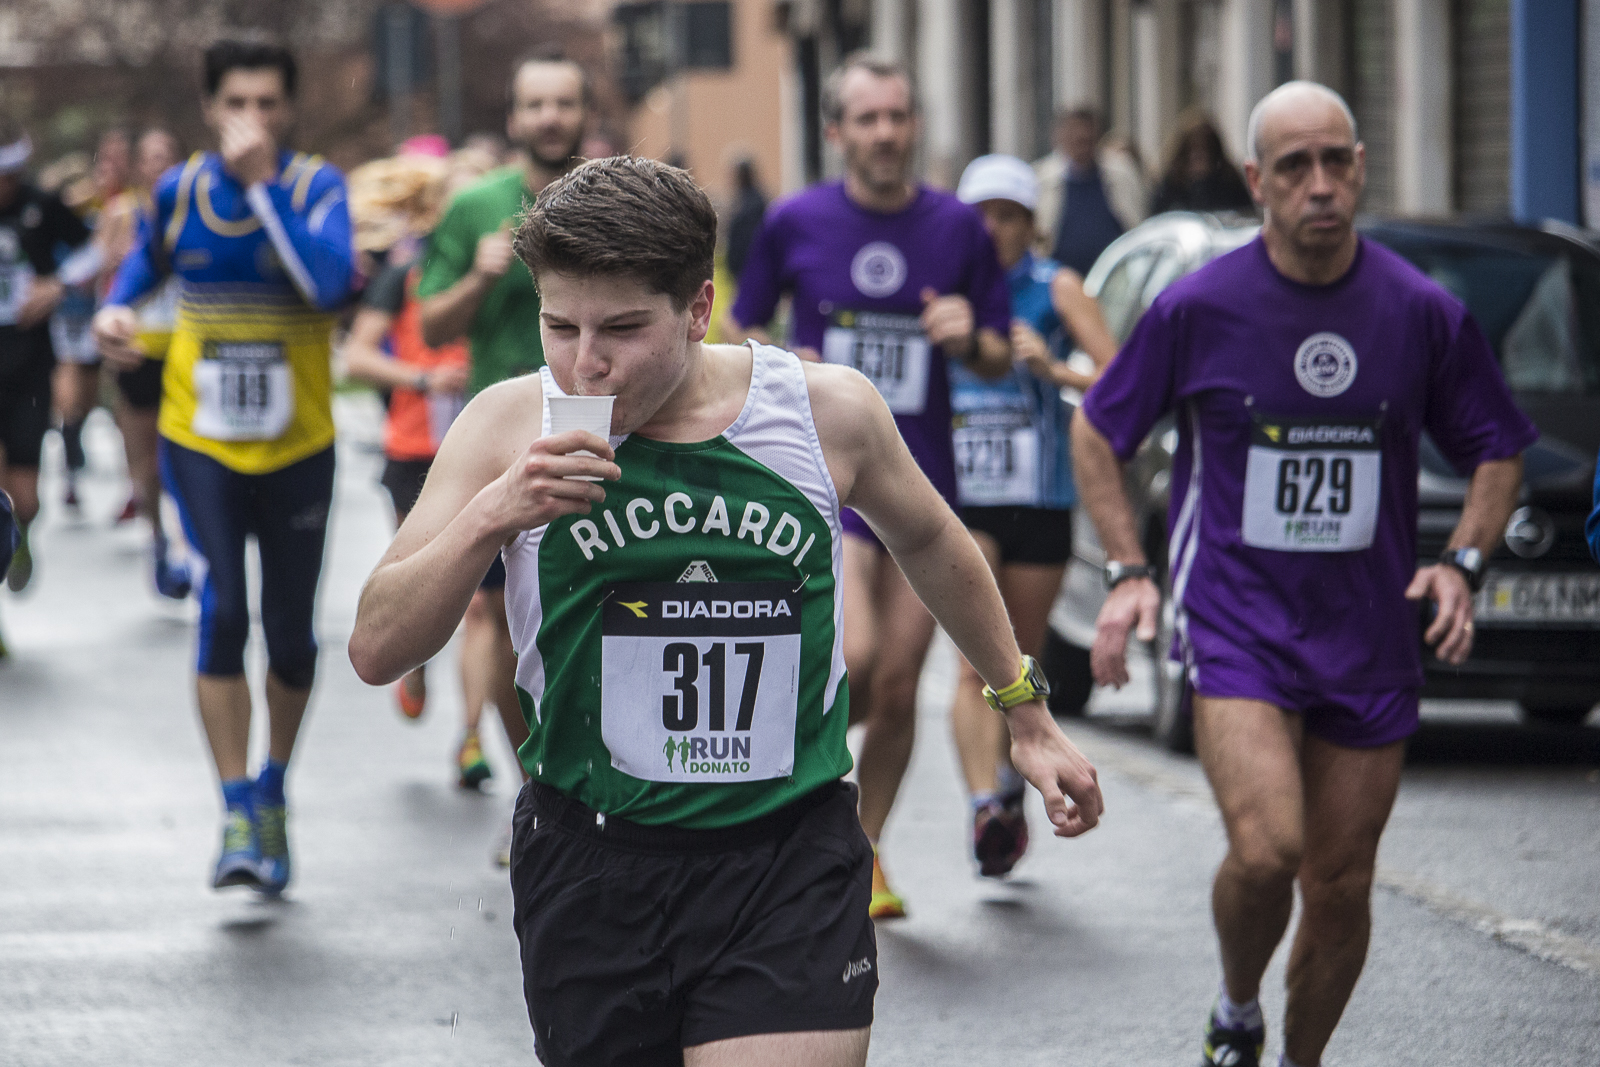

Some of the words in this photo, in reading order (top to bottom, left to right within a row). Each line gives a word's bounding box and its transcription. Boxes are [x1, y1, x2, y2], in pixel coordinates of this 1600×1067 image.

[1287, 425, 1374, 444] DIADORA
[1276, 458, 1352, 515] 629
[569, 492, 816, 567] RICCARDI
[661, 599, 792, 619] DIADORA
[662, 642, 765, 732] 317
[689, 736, 751, 760] RUN
[689, 761, 750, 774] DONATO
